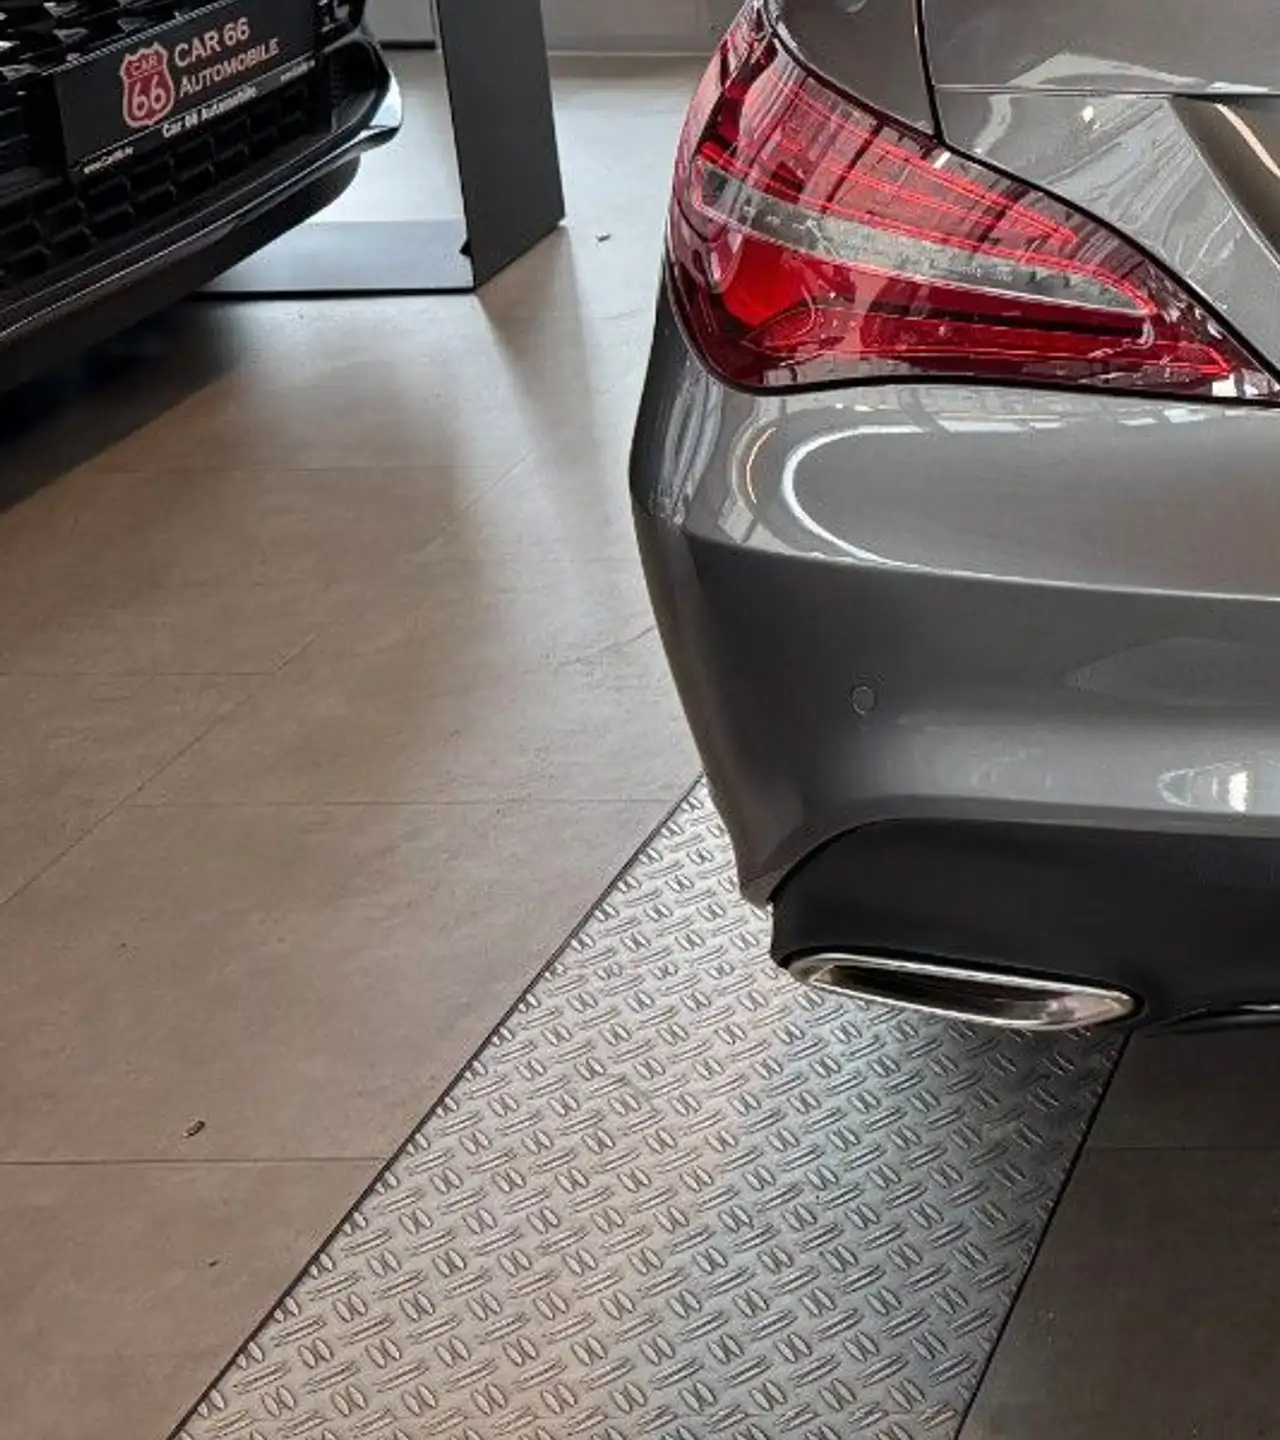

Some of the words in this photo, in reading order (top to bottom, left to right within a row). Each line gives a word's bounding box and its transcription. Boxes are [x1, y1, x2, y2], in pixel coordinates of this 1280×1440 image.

[131, 55, 158, 76] CAR
[174, 30, 222, 67] CAR
[223, 17, 251, 47] 66
[180, 38, 280, 98] AUTOMOBILE
[131, 74, 167, 118] 66
